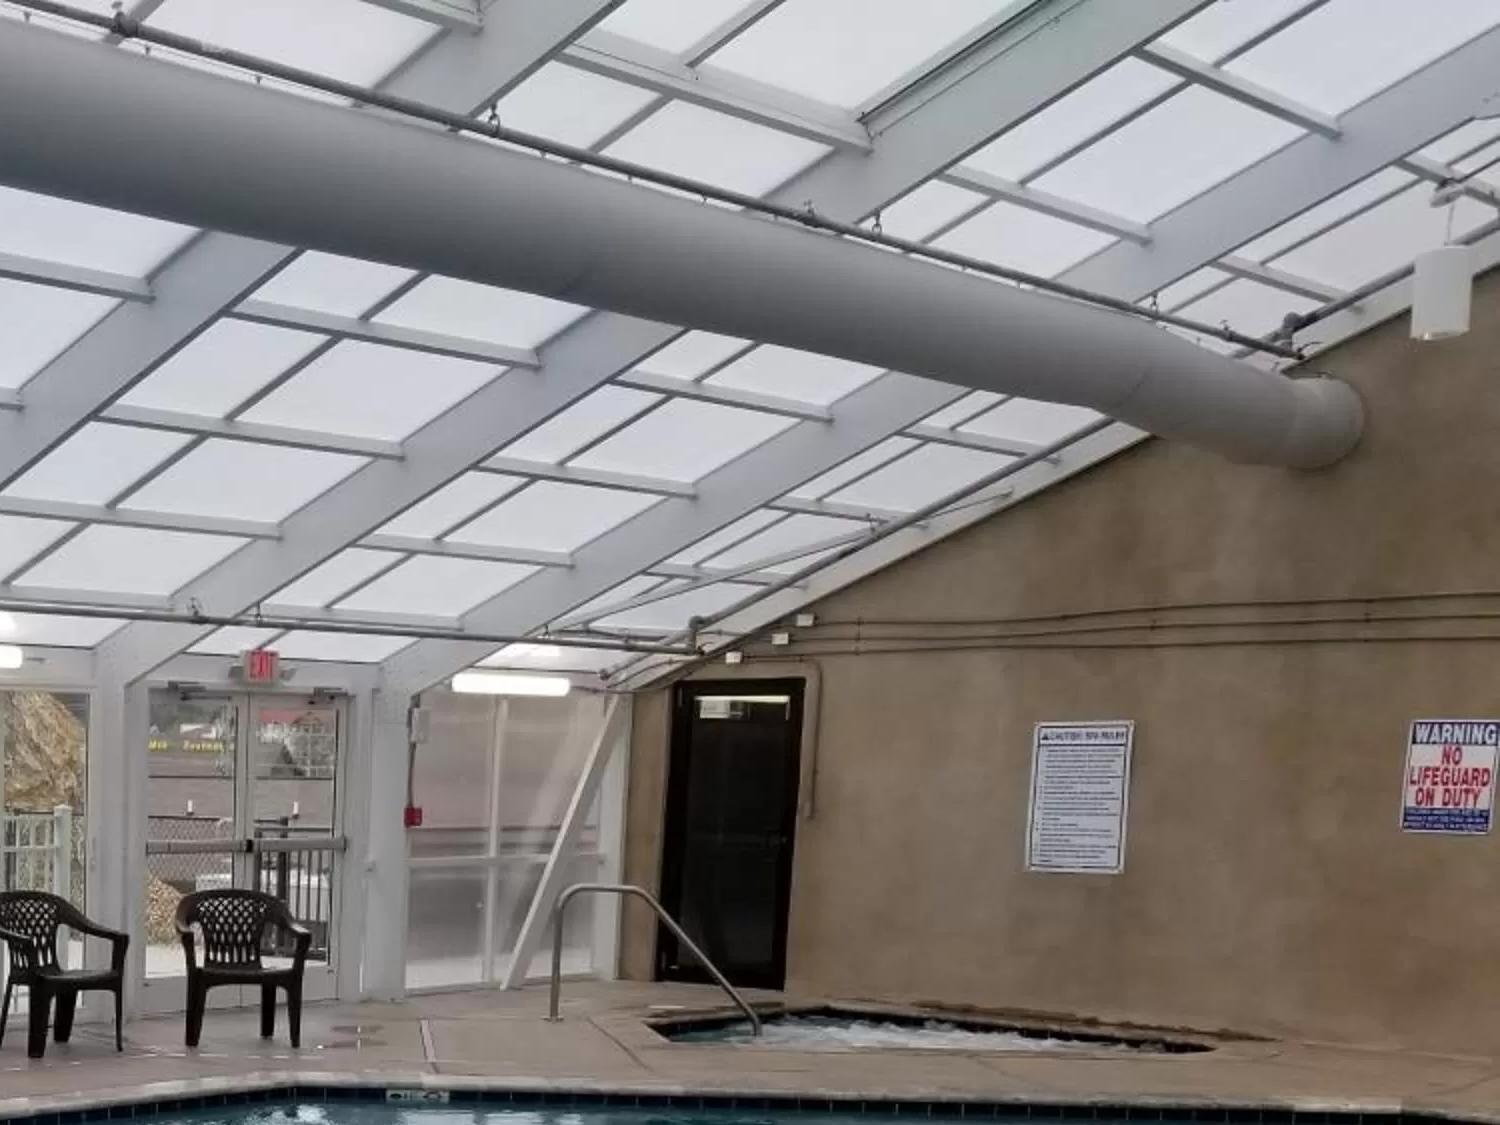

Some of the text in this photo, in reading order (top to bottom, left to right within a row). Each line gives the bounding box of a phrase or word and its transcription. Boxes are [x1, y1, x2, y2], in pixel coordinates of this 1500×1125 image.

[1415, 724, 1497, 744] WARNING
[1441, 746, 1462, 765] NO
[1410, 767, 1490, 786] LIFEGUARD
[1415, 788, 1481, 807] ON DUTY
